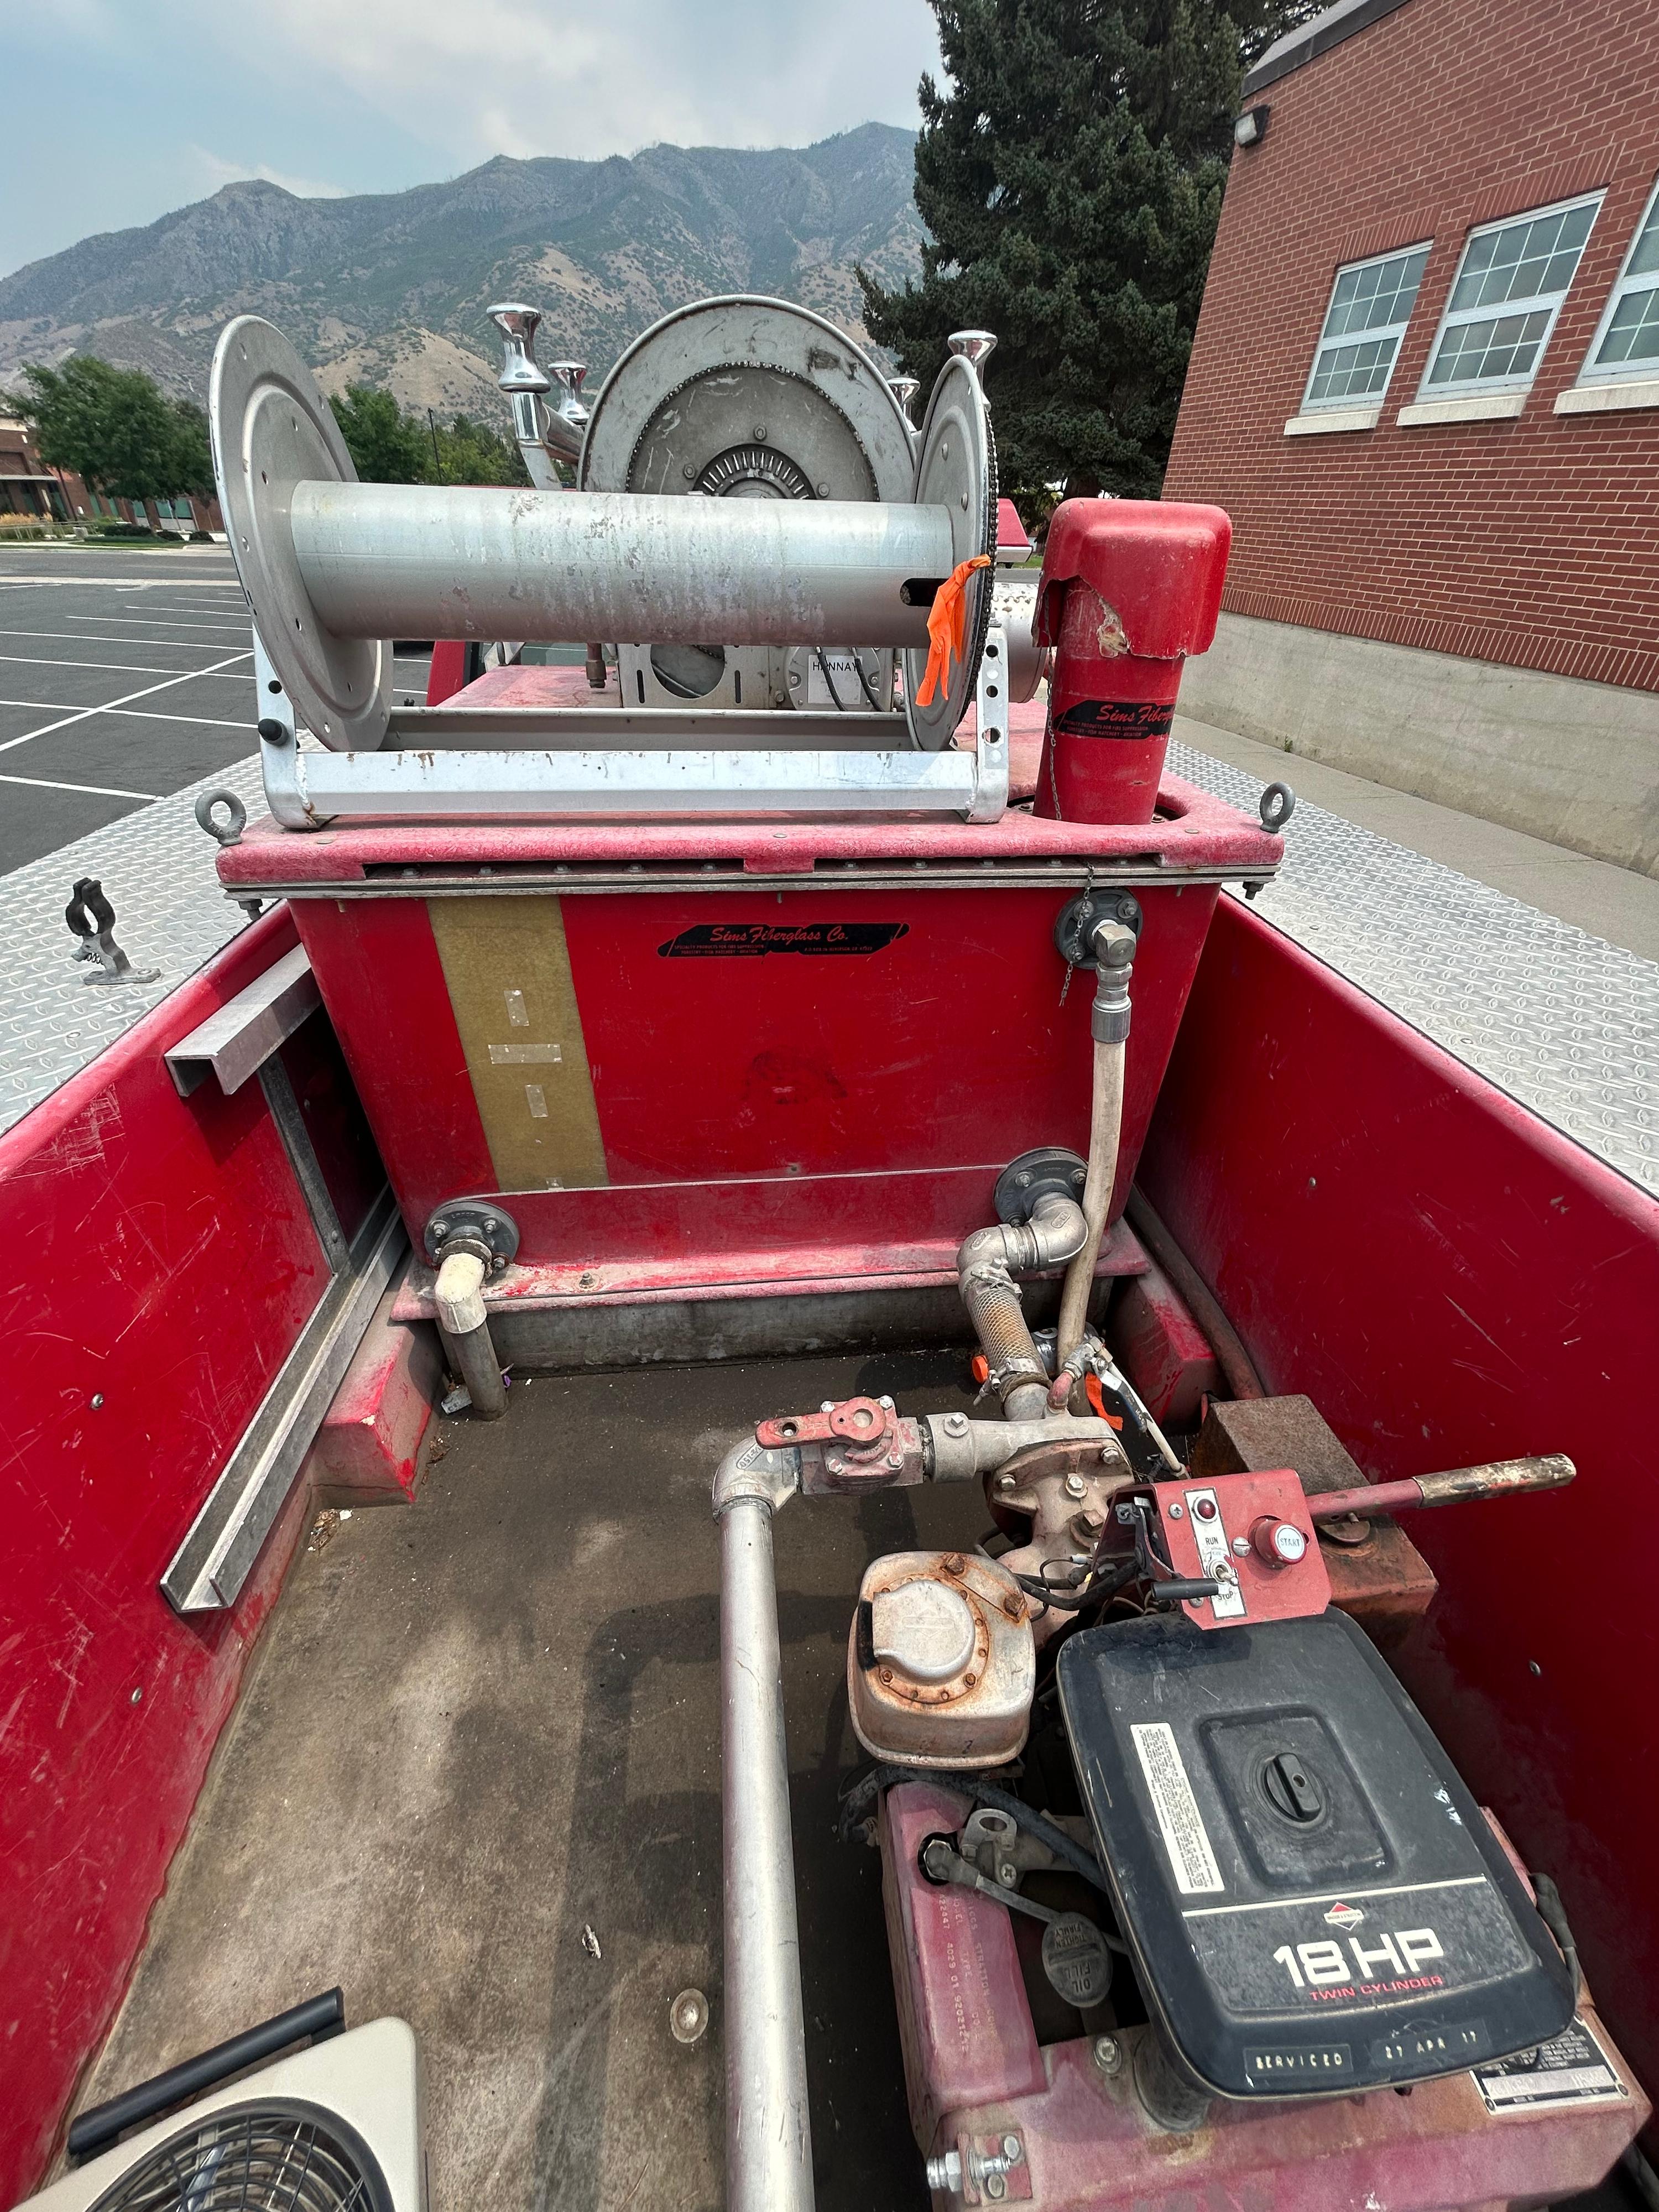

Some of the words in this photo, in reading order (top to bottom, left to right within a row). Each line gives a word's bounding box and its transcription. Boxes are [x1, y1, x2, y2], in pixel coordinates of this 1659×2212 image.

[812, 661, 857, 671] HNNAY
[1096, 705, 1135, 723] Sims
[710, 927, 748, 941] Sims
[749, 926, 821, 945] Fiberglass
[827, 926, 848, 942] Co.
[1206, 1536, 1219, 1545] RUN
[1280, 1537, 1300, 1547] START
[1217, 1591, 1234, 1601] STOP
[1055, 1923, 1081, 1937] FIRMLY
[1055, 1935, 1086, 1949] TIGHTEN
[947, 1942, 956, 1969] 4029
[1274, 1940, 1350, 1987] 18
[1348, 1928, 1444, 1979] HP
[1065, 1962, 1091, 1979] FILL
[951, 1975, 959, 1989] 01
[1072, 1978, 1091, 1993] OIL
[1310, 1986, 1355, 2002] TWIN
[1361, 1975, 1444, 1995] CYLINDER
[1255, 2052, 1343, 2069] SERVICED
[1416, 2037, 1446, 2054] APR
